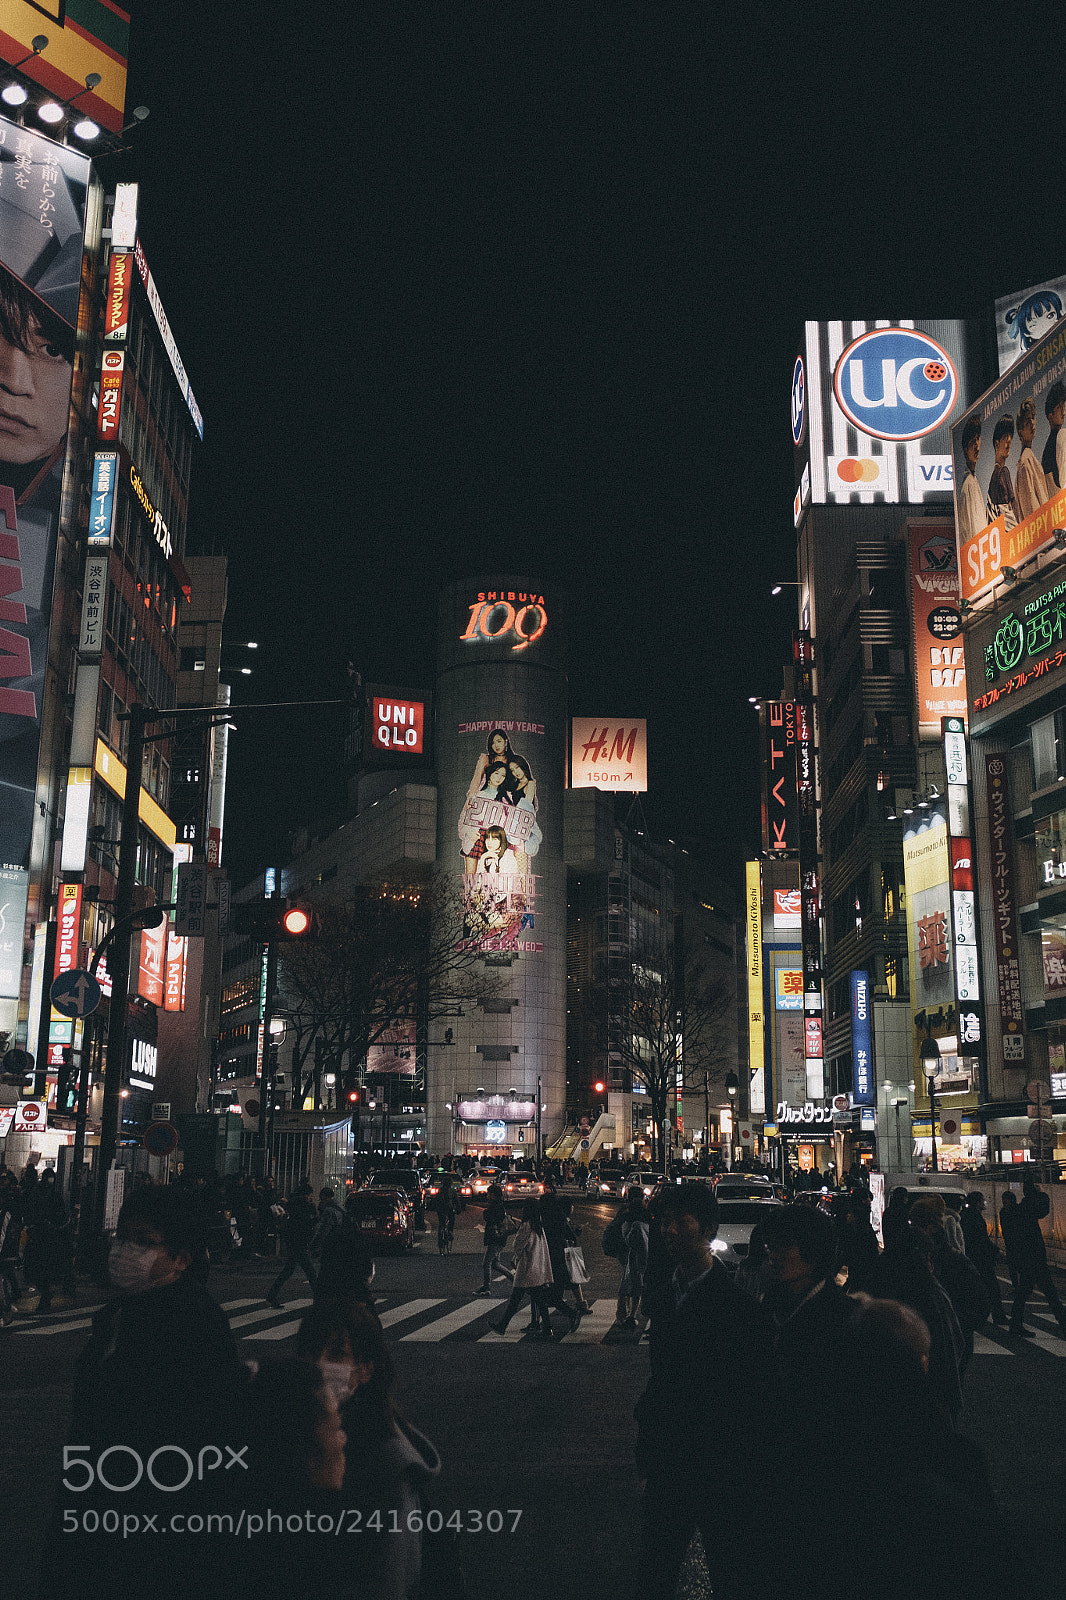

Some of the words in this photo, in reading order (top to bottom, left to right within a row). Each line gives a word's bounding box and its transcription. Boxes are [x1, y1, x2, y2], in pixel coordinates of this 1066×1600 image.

[112, 330, 125, 339] 8F
[984, 394, 1002, 421] JAPAN
[1013, 361, 1036, 393] ALBUM
[1033, 375, 1047, 398] NOW
[1047, 365, 1058, 383] ON
[102, 388, 119, 432] ガスト
[1009, 537, 1016, 559] A
[1017, 511, 1048, 553] HAPPY
[968, 526, 1001, 587] SF9
[84, 565, 103, 645] 渋谷駅前ビル
[477, 591, 545, 605] SHIBUYA
[459, 600, 548, 650] 109
[378, 704, 414, 725] UNI
[466, 720, 492, 732] HAPPY
[495, 720, 514, 731] NEW
[516, 721, 537, 733] YEAR
[785, 703, 795, 747] TOKYO
[377, 725, 417, 747] QLO
[582, 727, 638, 764] H&M
[464, 798, 535, 840] 2018
[906, 841, 939, 861] Matsumoto
[953, 858, 971, 870] JTB
[991, 791, 1013, 945] ウィンターフルーツギフト
[517, 942, 536, 951] WED
[751, 923, 760, 978] Matsumoto
[917, 911, 950, 969] 薬
[168, 963, 180, 995] アコム
[856, 979, 867, 1020] MIZUHO
[131, 1038, 158, 1078] LUSH
[776, 1100, 834, 1123] グルメタウン
